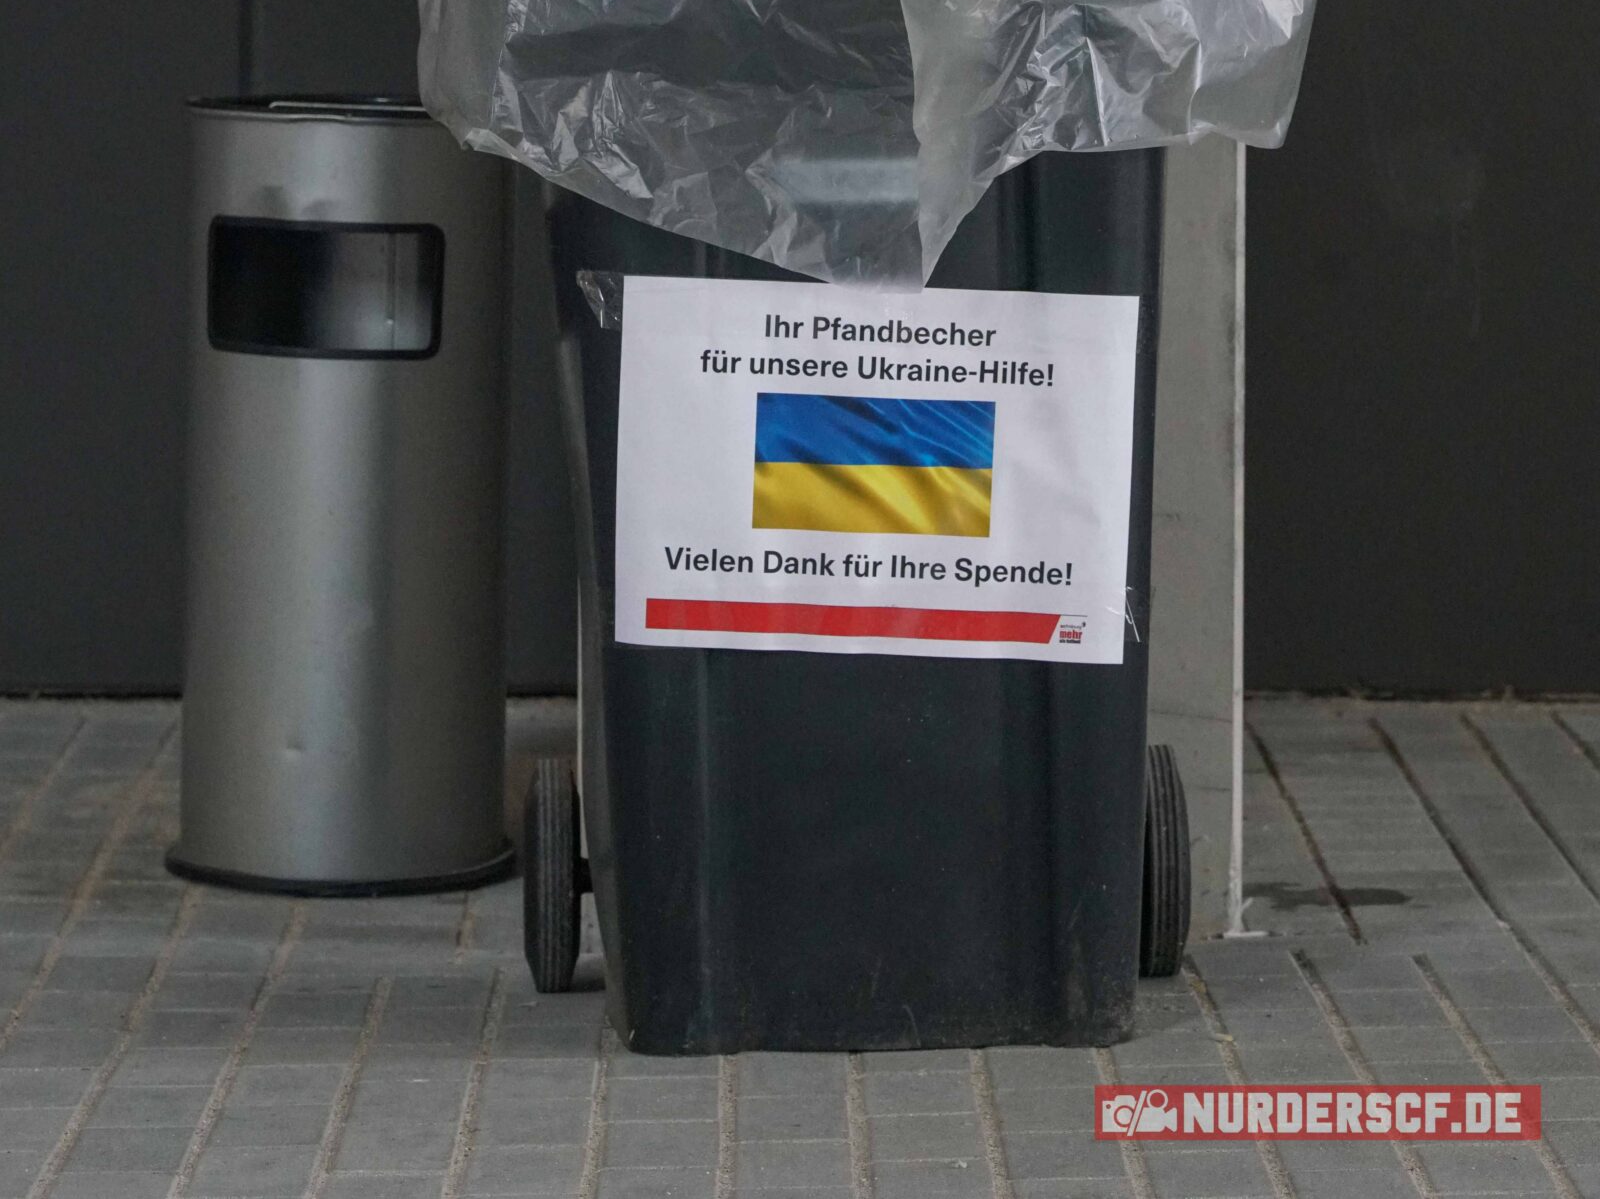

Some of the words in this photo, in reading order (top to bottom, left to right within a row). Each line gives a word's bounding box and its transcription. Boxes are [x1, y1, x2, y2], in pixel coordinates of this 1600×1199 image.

[765, 314, 804, 338] Ihr
[812, 316, 996, 346] Pfandbecher
[700, 349, 741, 373] für
[749, 357, 848, 378] unsere
[857, 355, 1053, 386] Ukraine-Hilfe!
[664, 546, 753, 573] Vielen
[763, 550, 834, 576] Dank
[842, 553, 882, 577] für
[890, 554, 946, 580] Ihre
[954, 557, 1072, 587] Spende!
[1059, 629, 1083, 639] mehr
